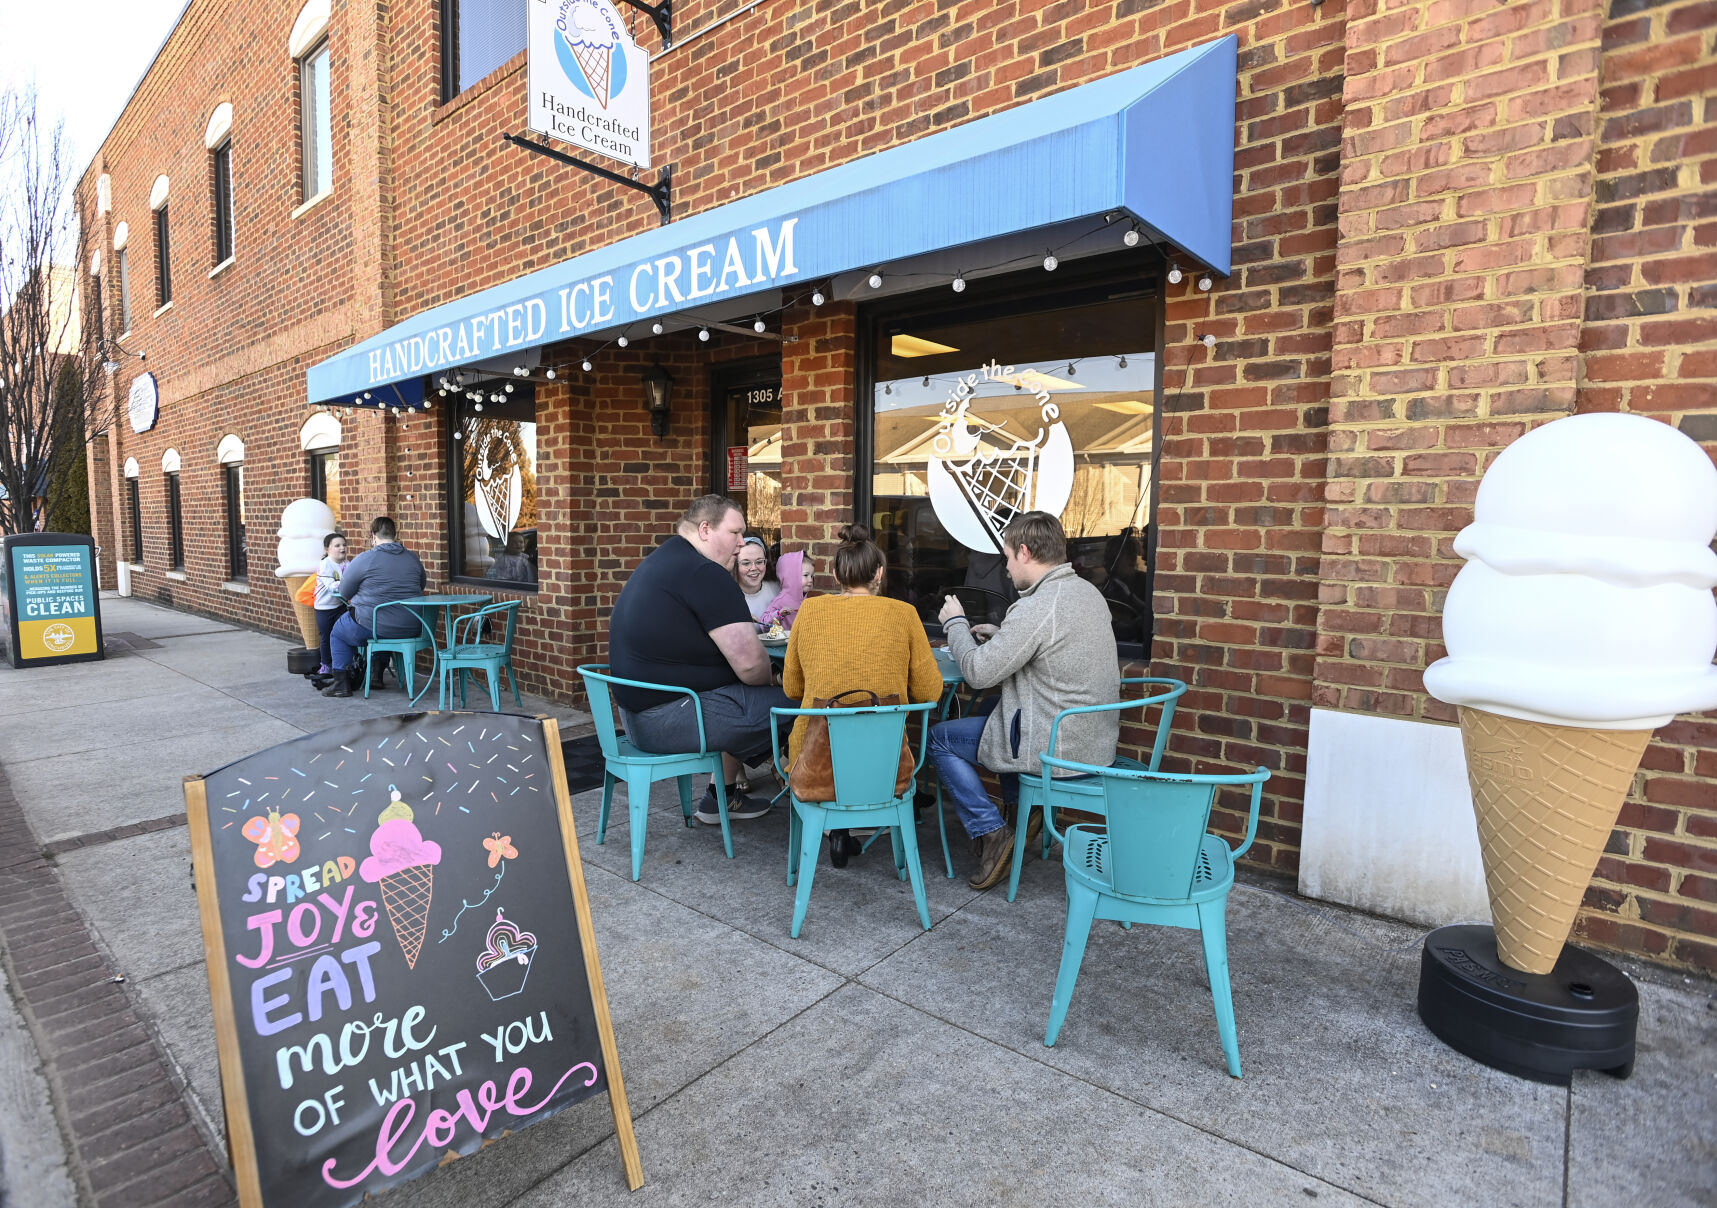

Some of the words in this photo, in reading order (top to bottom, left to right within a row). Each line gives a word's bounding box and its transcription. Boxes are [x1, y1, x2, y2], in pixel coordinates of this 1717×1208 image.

[600, 7, 620, 40] Cone
[541, 92, 640, 142] Handcrafted
[551, 115, 576, 137] Ice
[581, 125, 633, 157] Cream
[368, 297, 548, 384] HANDCRAFTED
[557, 275, 616, 334] ICE
[629, 217, 800, 314] CREAM
[747, 389, 773, 403] 1305
[934, 373, 979, 453] Outside
[980, 358, 1015, 379] the
[475, 433, 492, 480] Outside
[491, 426, 503, 439] the
[43, 564, 56, 572] 5X
[27, 601, 86, 616] CLEAN
[242, 856, 356, 904] SPREAD
[236, 885, 355, 969] JOY
[251, 941, 381, 1037] EAT
[276, 1005, 437, 1090] more
[293, 1085, 346, 1136] OF
[368, 1041, 467, 1107] WHAT
[481, 1011, 553, 1063] YOU
[322, 1062, 598, 1189] love
